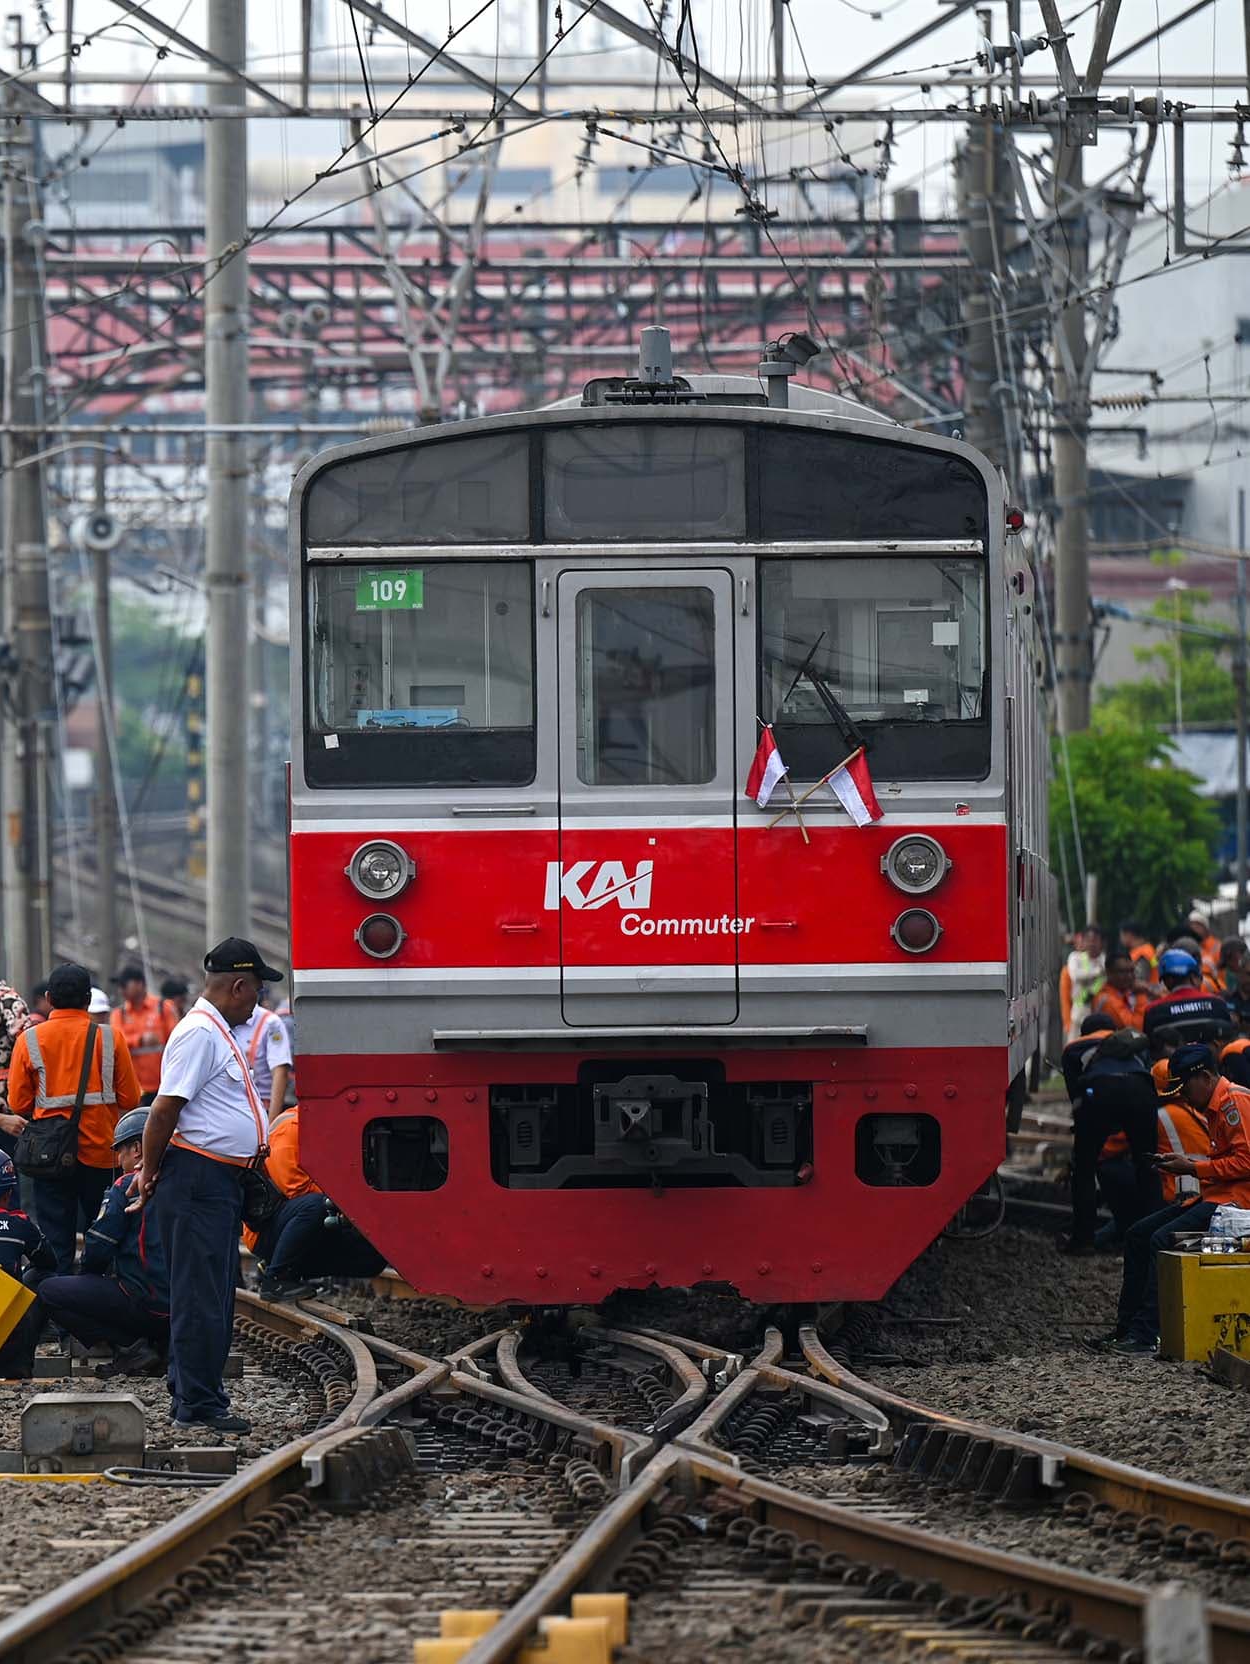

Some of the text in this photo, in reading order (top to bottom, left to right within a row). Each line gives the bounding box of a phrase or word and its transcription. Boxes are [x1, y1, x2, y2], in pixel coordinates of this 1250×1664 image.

[370, 579, 407, 602] 109
[544, 860, 654, 911] KAI
[620, 913, 755, 935] Commuter
